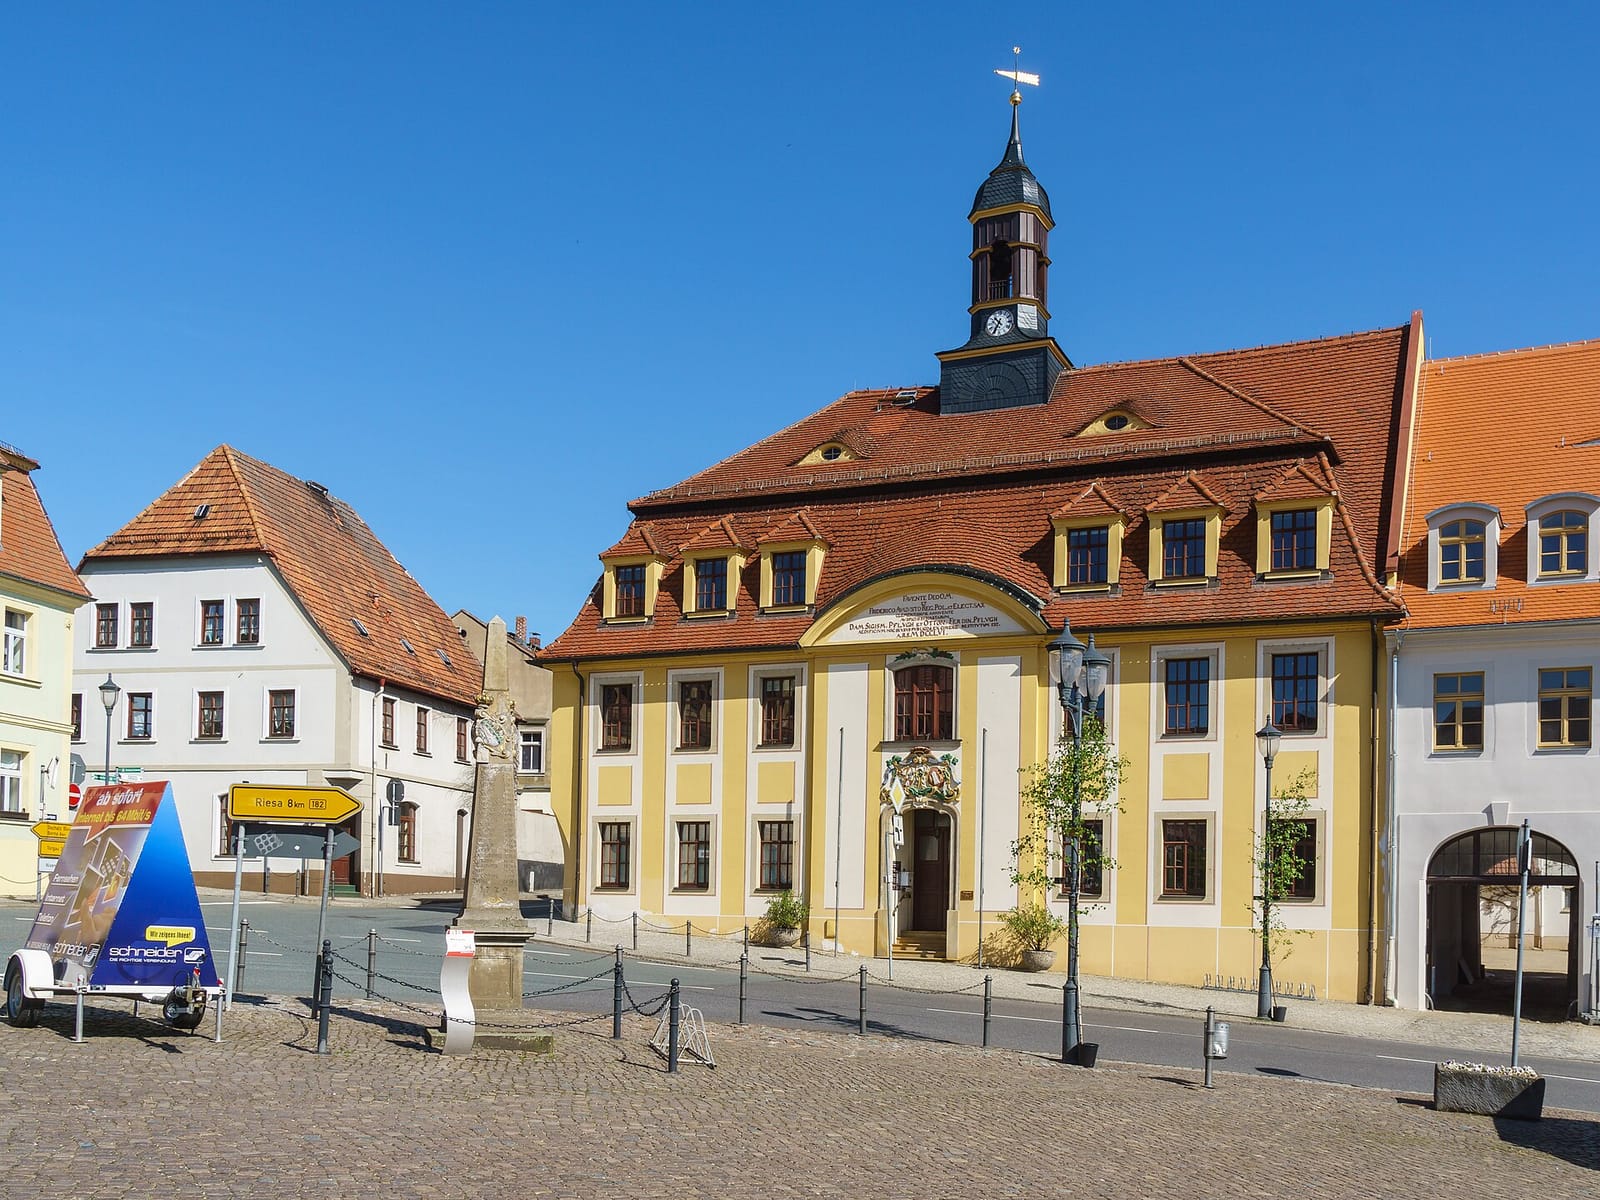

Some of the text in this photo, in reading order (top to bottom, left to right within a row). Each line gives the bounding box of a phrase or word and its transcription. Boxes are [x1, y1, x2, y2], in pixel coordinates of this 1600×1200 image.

[96, 788, 144, 806] ab sofort
[255, 797, 283, 807] Riesa
[311, 800, 324, 808] 182
[109, 946, 182, 957] schneider
